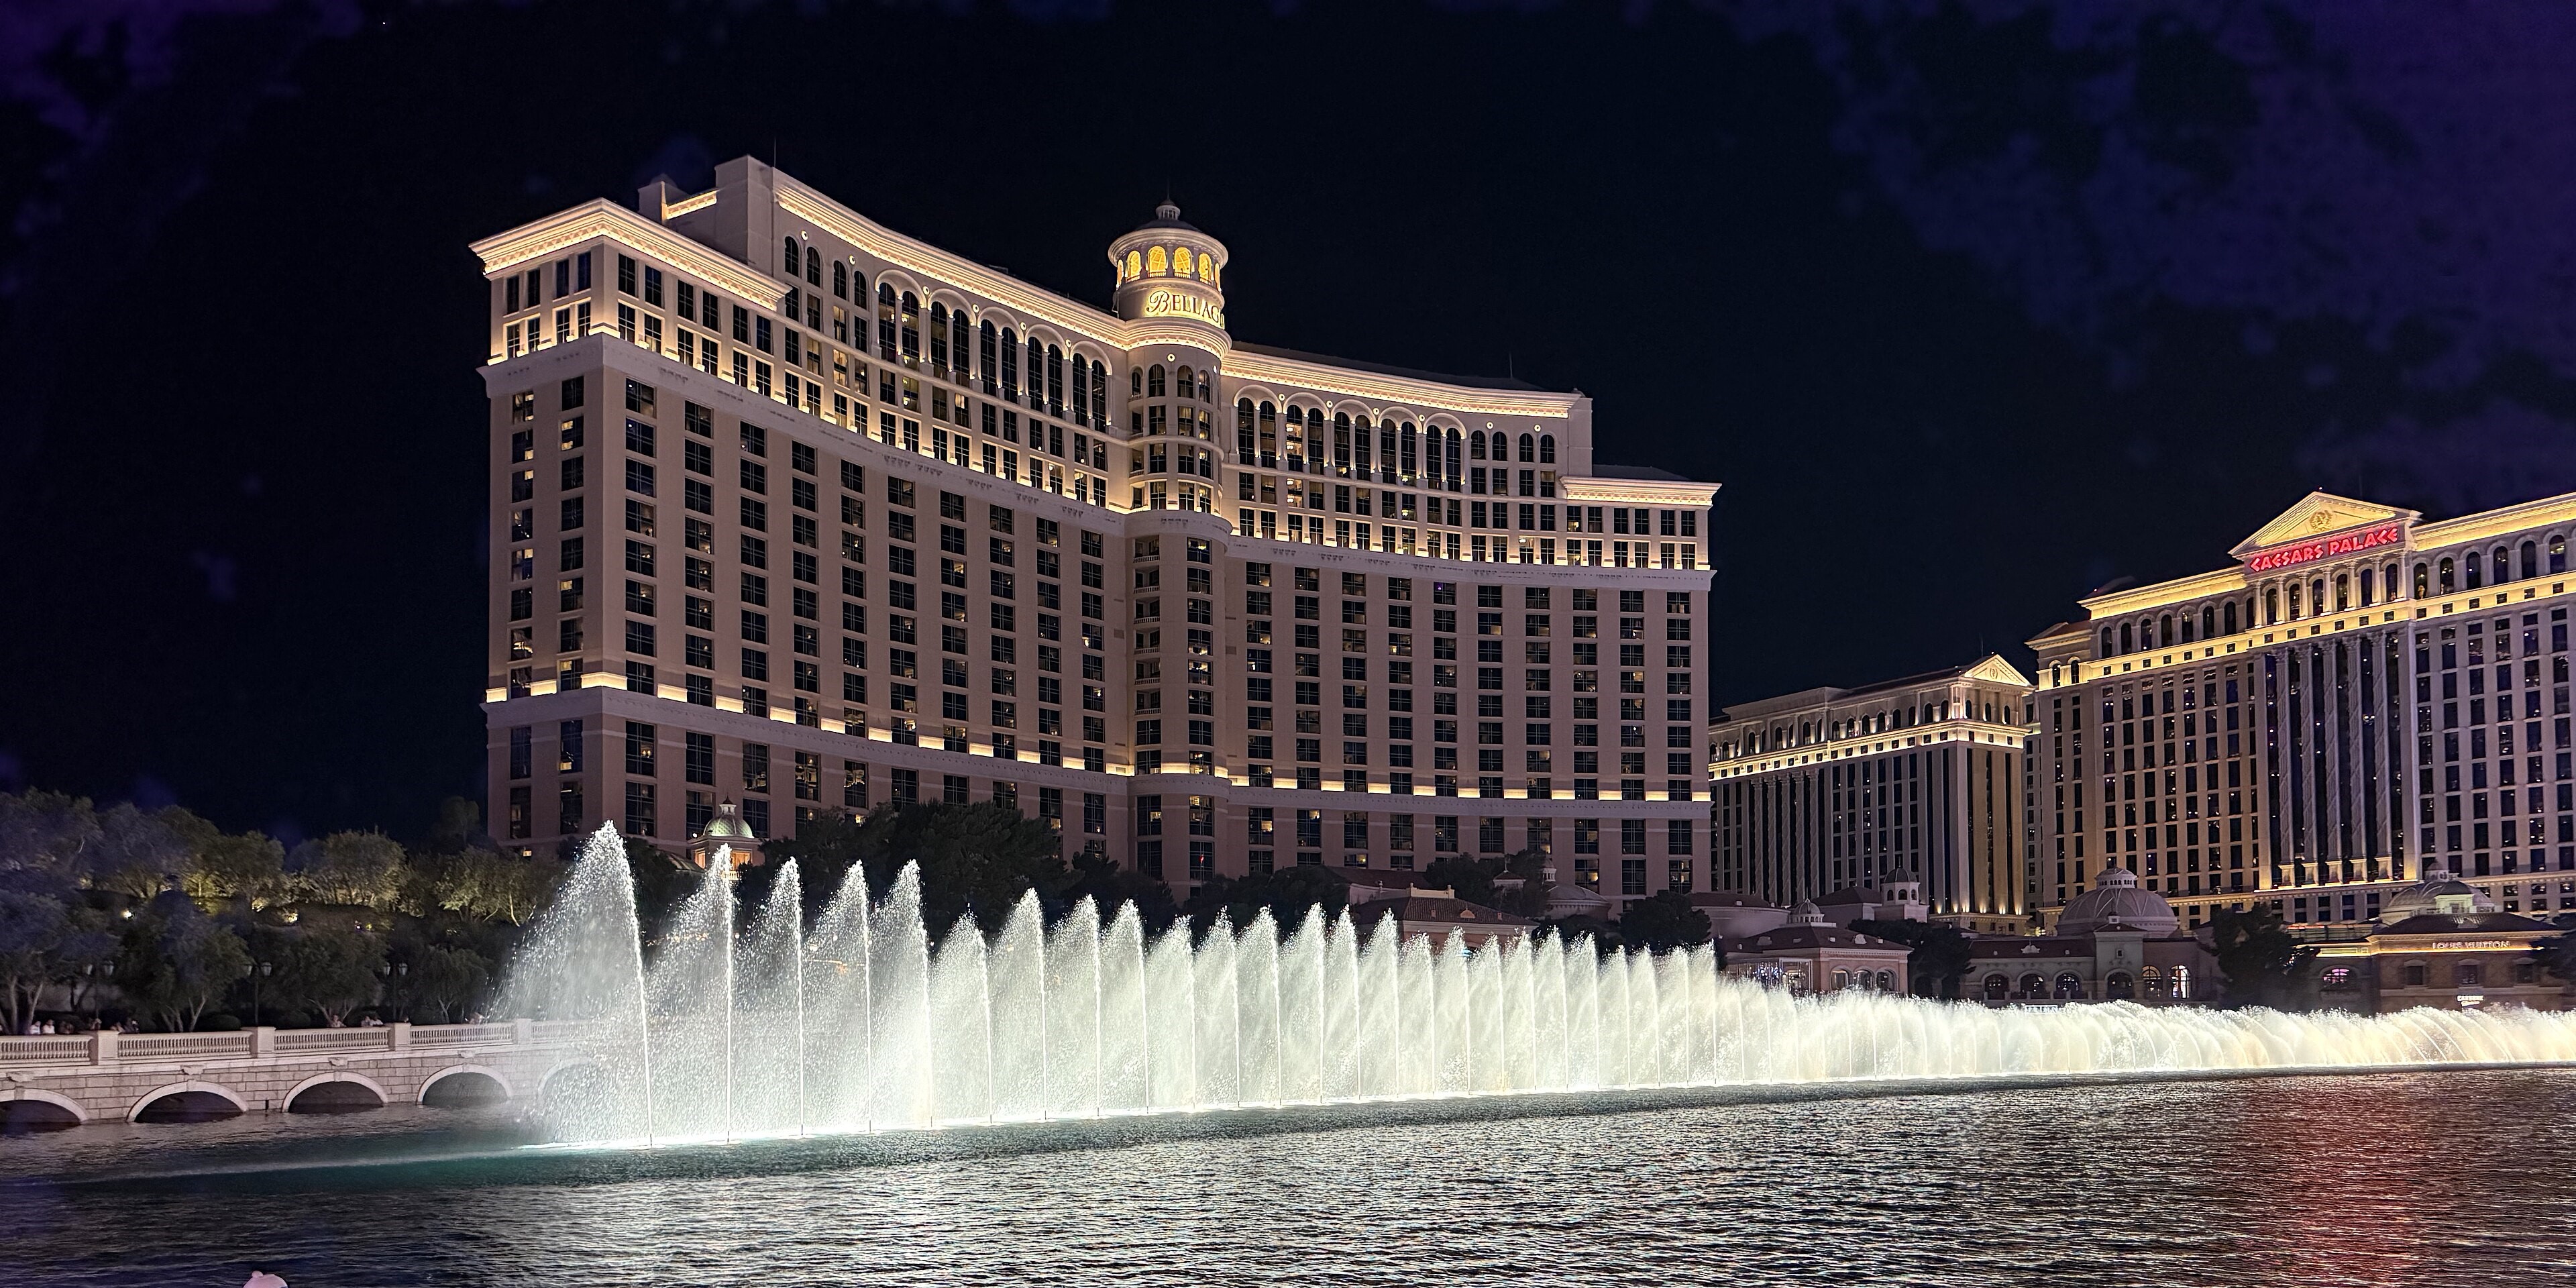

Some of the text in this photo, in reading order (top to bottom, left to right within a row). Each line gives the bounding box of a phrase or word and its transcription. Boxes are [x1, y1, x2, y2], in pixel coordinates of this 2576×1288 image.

[2250, 528, 2398, 572] CAESARS PALACE
[2465, 941, 2510, 949] VUITTON
